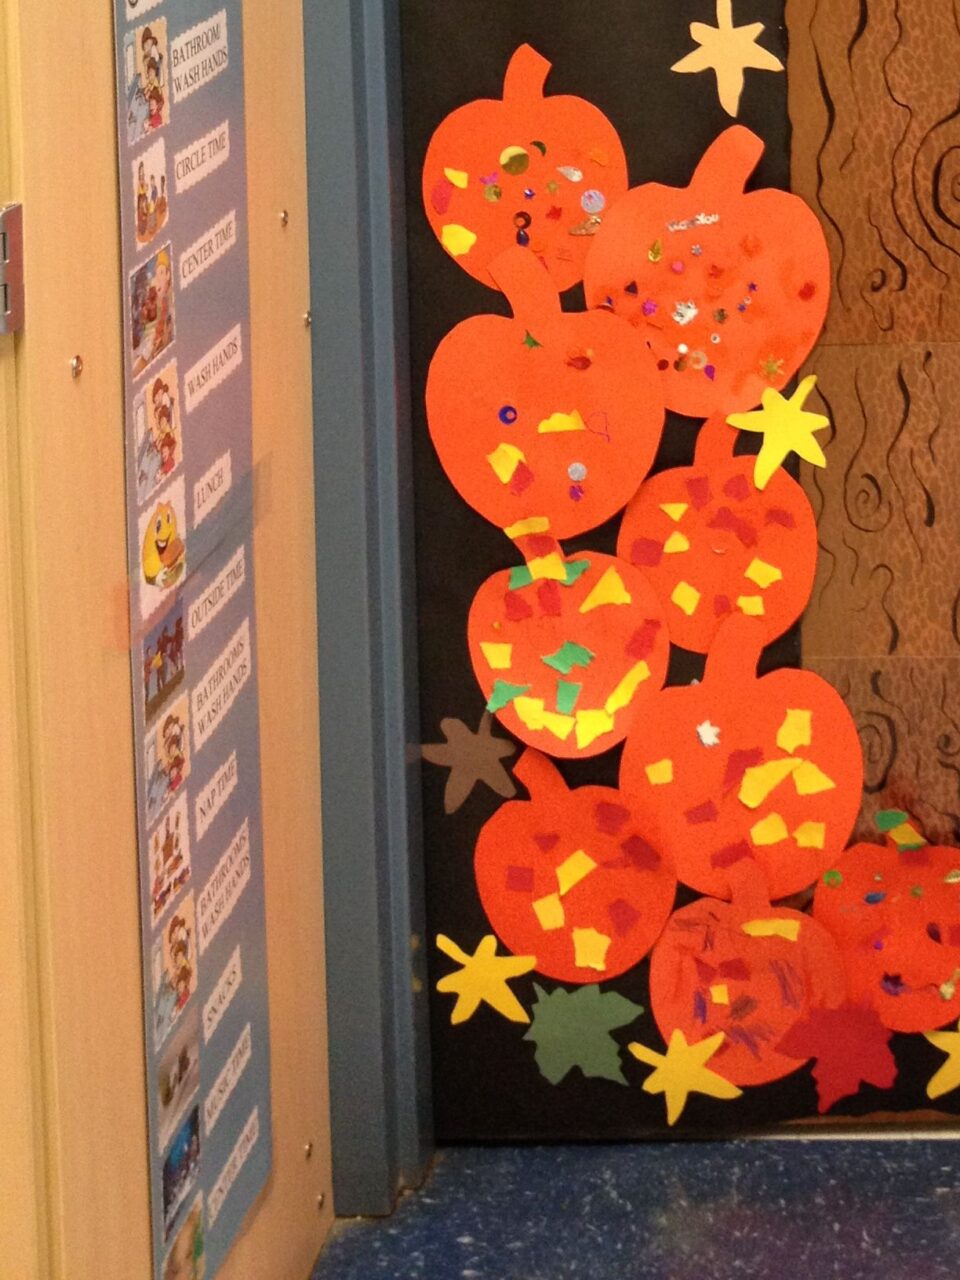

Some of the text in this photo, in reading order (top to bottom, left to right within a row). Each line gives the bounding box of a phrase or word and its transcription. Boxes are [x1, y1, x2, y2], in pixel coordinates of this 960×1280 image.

[174, 44, 228, 94] WASH HANDS
[176, 131, 226, 181] CIRCLE TIME
[181, 221, 234, 279] CENTER TIME
[187, 358, 212, 397] WASH
[196, 467, 224, 508] LUNCH
[191, 557, 243, 629] OUTSIDE TIME
